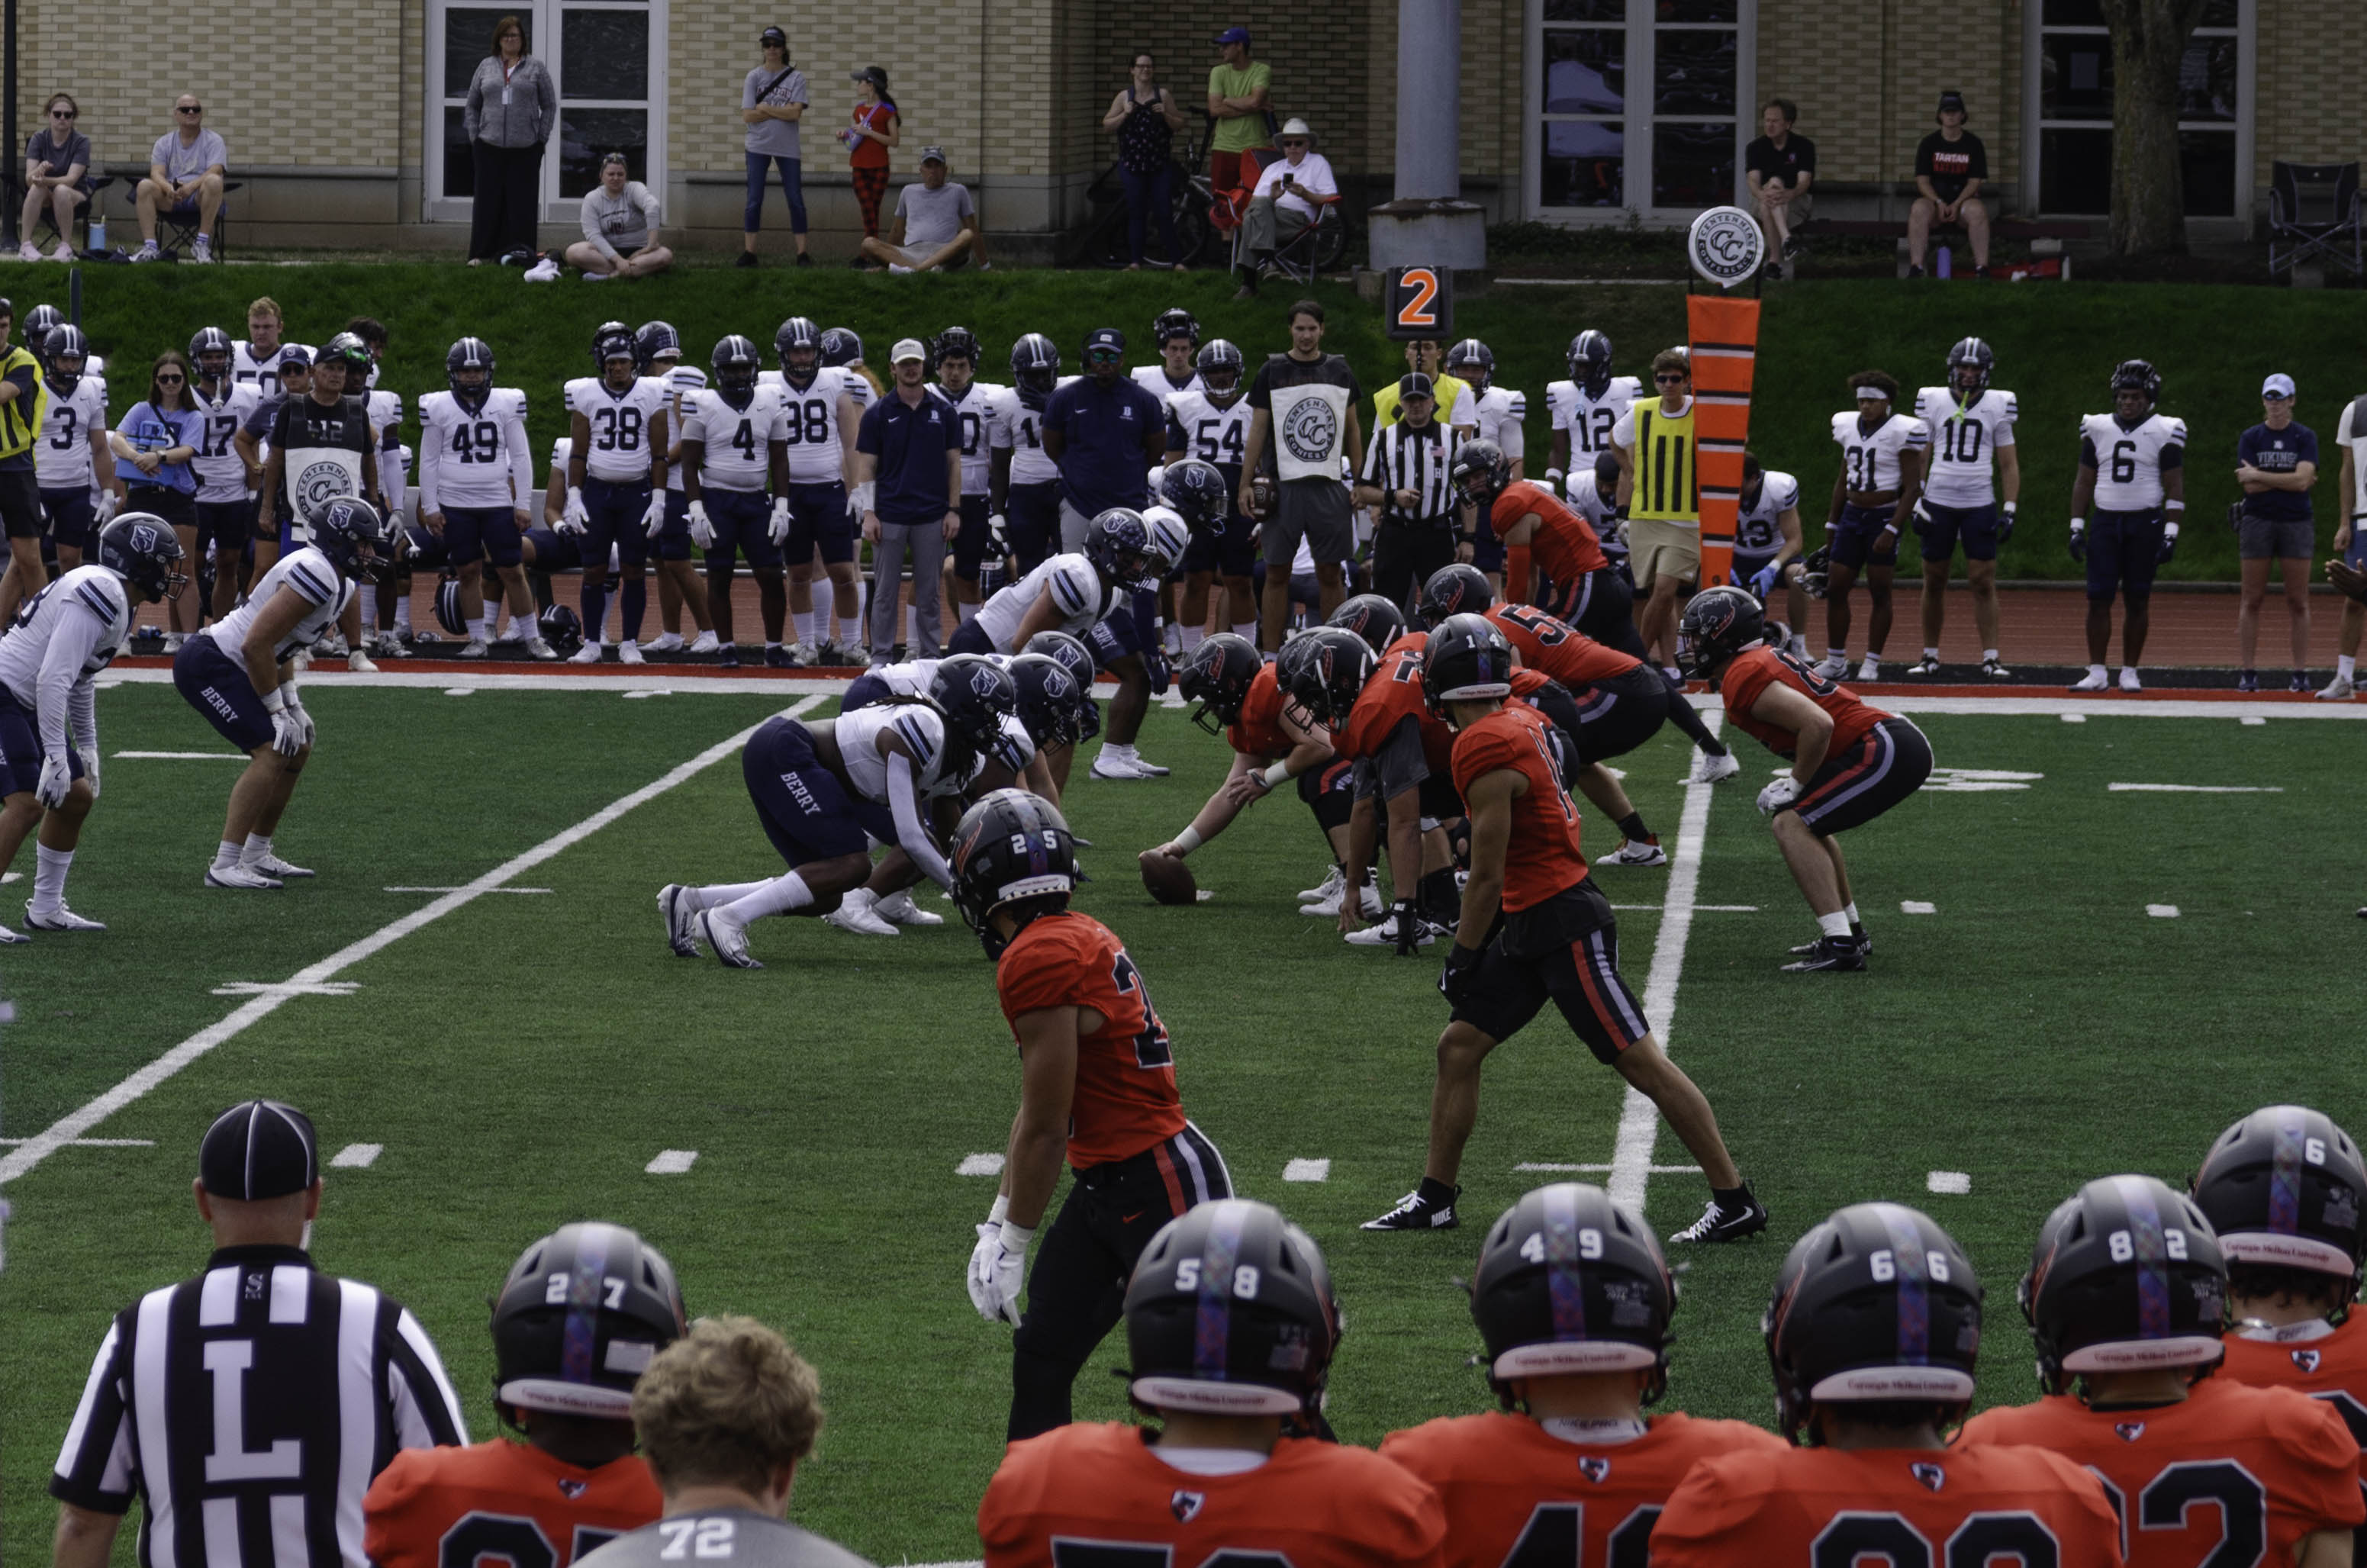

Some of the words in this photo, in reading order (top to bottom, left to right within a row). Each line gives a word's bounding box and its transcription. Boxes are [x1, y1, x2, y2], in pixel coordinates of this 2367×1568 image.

[1700, 214, 1754, 246] CENTENNIAL
[1699, 240, 1754, 275] CONFERENCE
[1398, 269, 1439, 326] 2
[50, 407, 76, 449] 3
[201, 415, 237, 456] 17
[452, 421, 498, 463] 49
[594, 407, 641, 451] 38
[729, 418, 753, 461] 4
[1195, 419, 1243, 463] 54
[1576, 407, 1613, 452] 12
[1943, 418, 1982, 463] 10
[298, 464, 349, 494] CENTENNIAL
[1846, 446, 1877, 492] 31
[2112, 448, 2136, 484] 6
[1466, 633, 1501, 649] 14
[199, 686, 238, 723] BERRY
[779, 771, 821, 815] BERRY
[1011, 829, 1058, 854] 25
[2305, 1138, 2325, 1166] 6
[1431, 1206, 1451, 1228] NIKE
[1520, 1228, 1603, 1263] 49
[1868, 1249, 1949, 1283] 66
[2108, 1228, 2188, 1264] 82
[546, 1272, 626, 1310] 27
[1175, 1258, 1258, 1300] 58
[203, 1339, 303, 1483] L
[659, 1517, 734, 1560] 72
